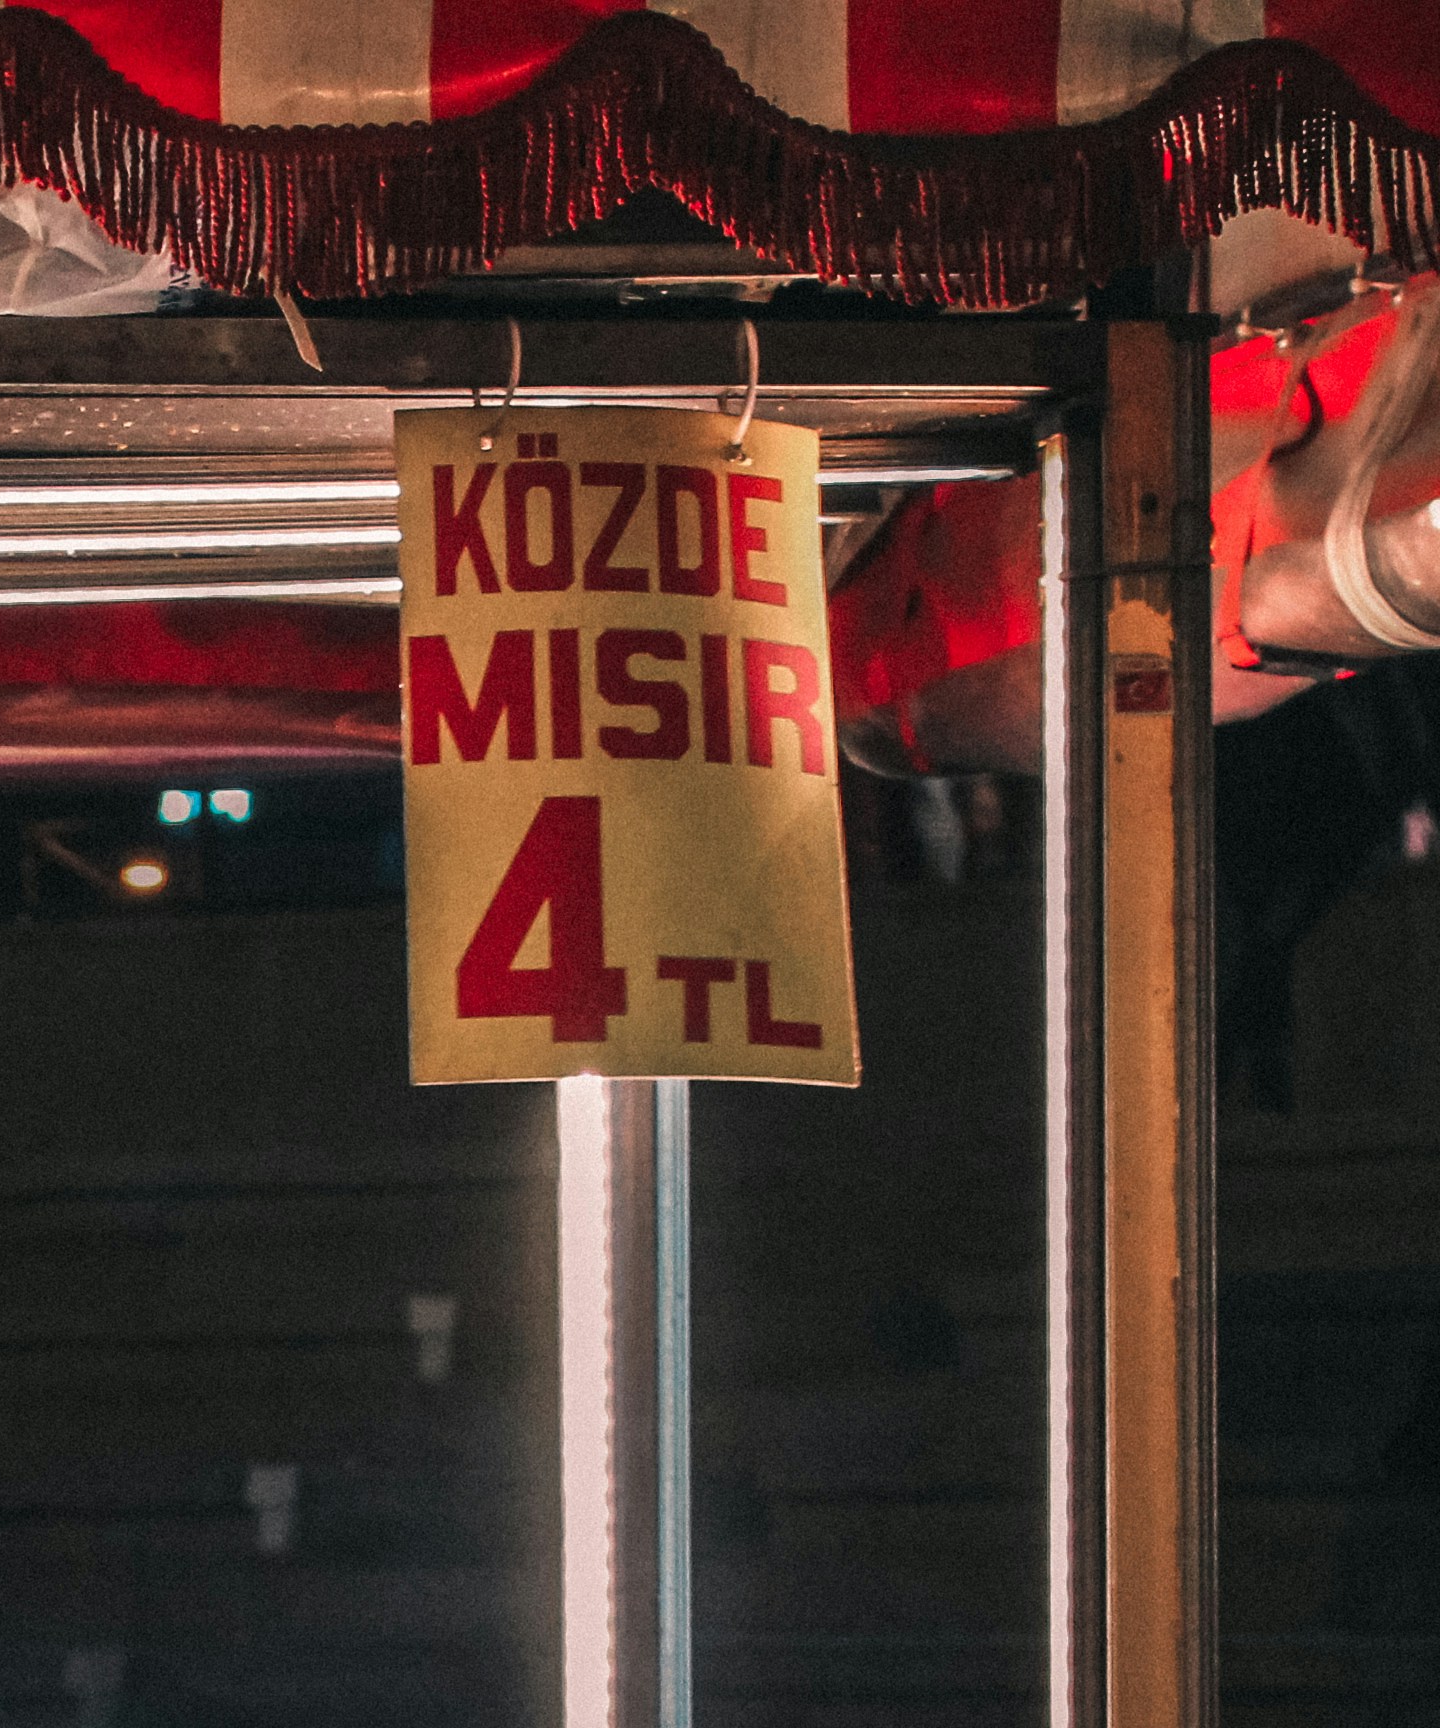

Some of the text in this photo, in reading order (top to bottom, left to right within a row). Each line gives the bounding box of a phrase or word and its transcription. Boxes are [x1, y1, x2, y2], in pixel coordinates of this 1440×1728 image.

[432, 433, 788, 607] KÖZDE
[408, 629, 826, 776] MISIR
[456, 795, 822, 1049] 4 TL
